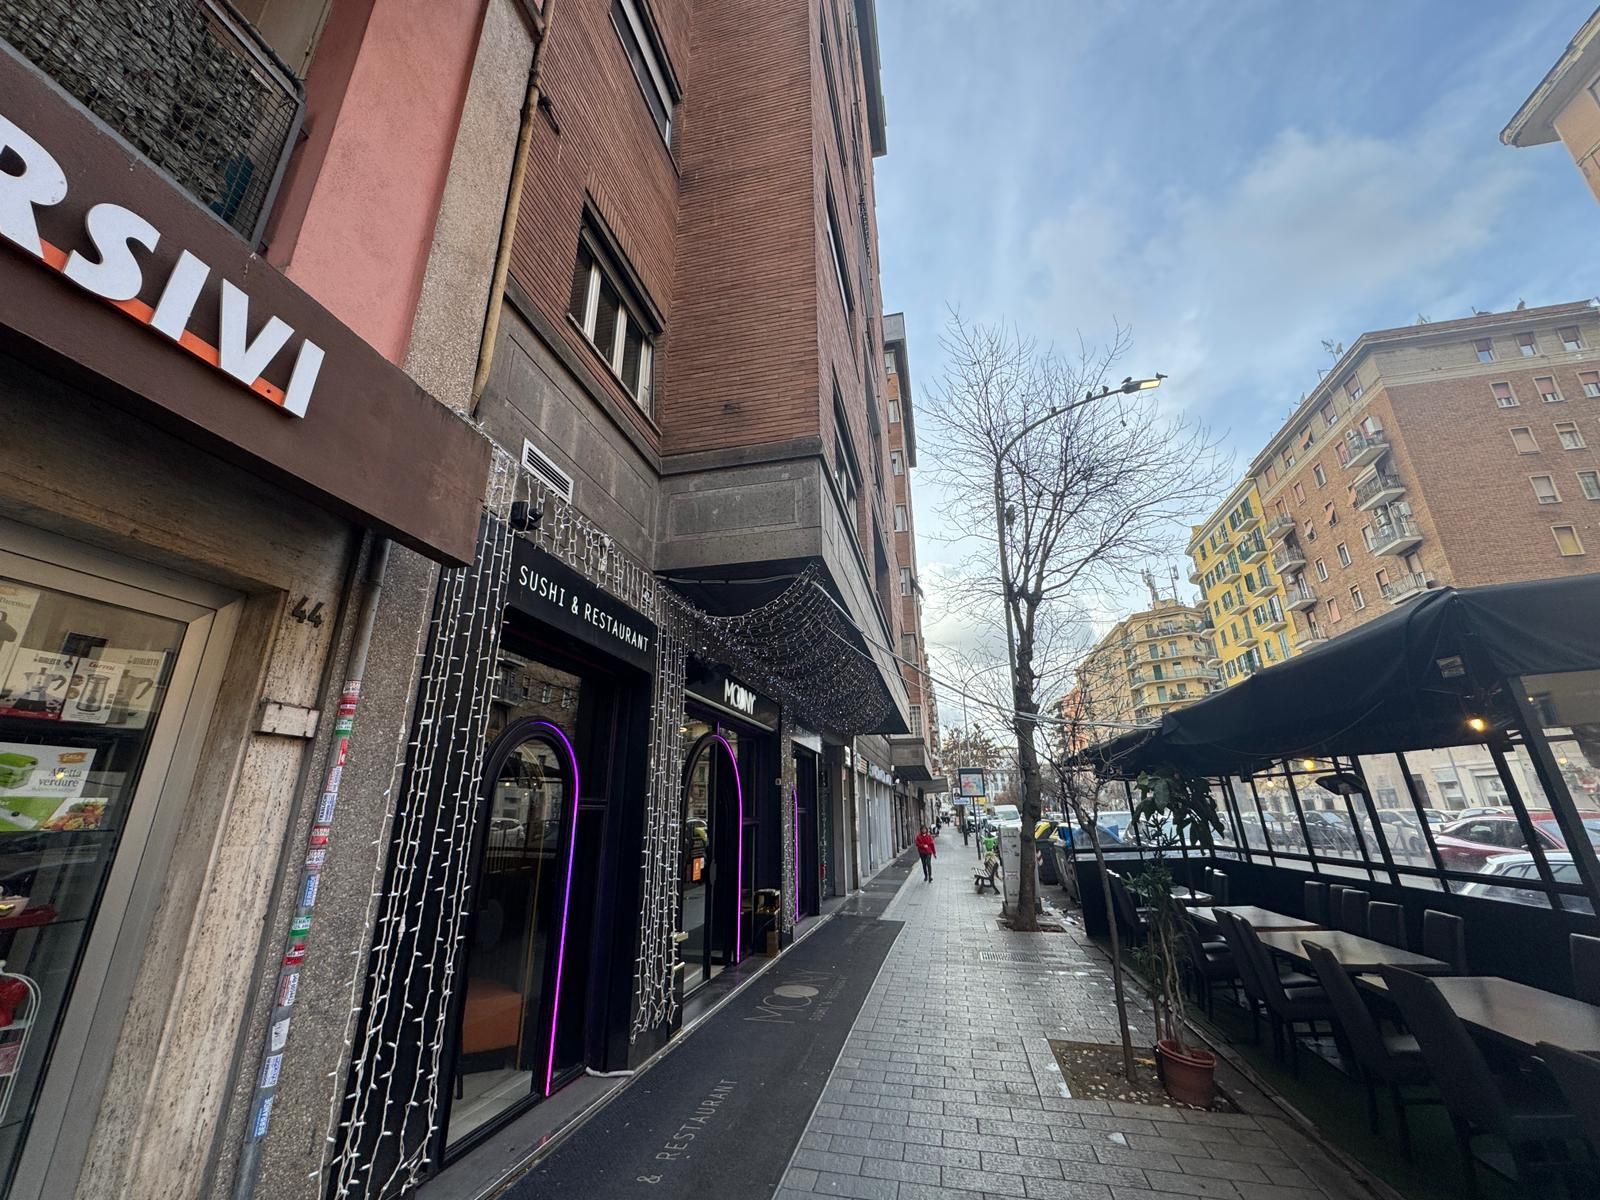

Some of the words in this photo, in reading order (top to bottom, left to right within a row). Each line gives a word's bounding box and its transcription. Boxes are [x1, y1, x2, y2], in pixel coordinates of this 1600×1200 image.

[0, 115, 325, 419] RSIVI
[292, 596, 323, 628] 44
[519, 565, 565, 607] SUSHI
[571, 595, 579, 615] &
[584, 603, 649, 652] RESTAURANT
[637, 1173, 664, 1184] &
[655, 1079, 738, 1160] RESTAURANT
